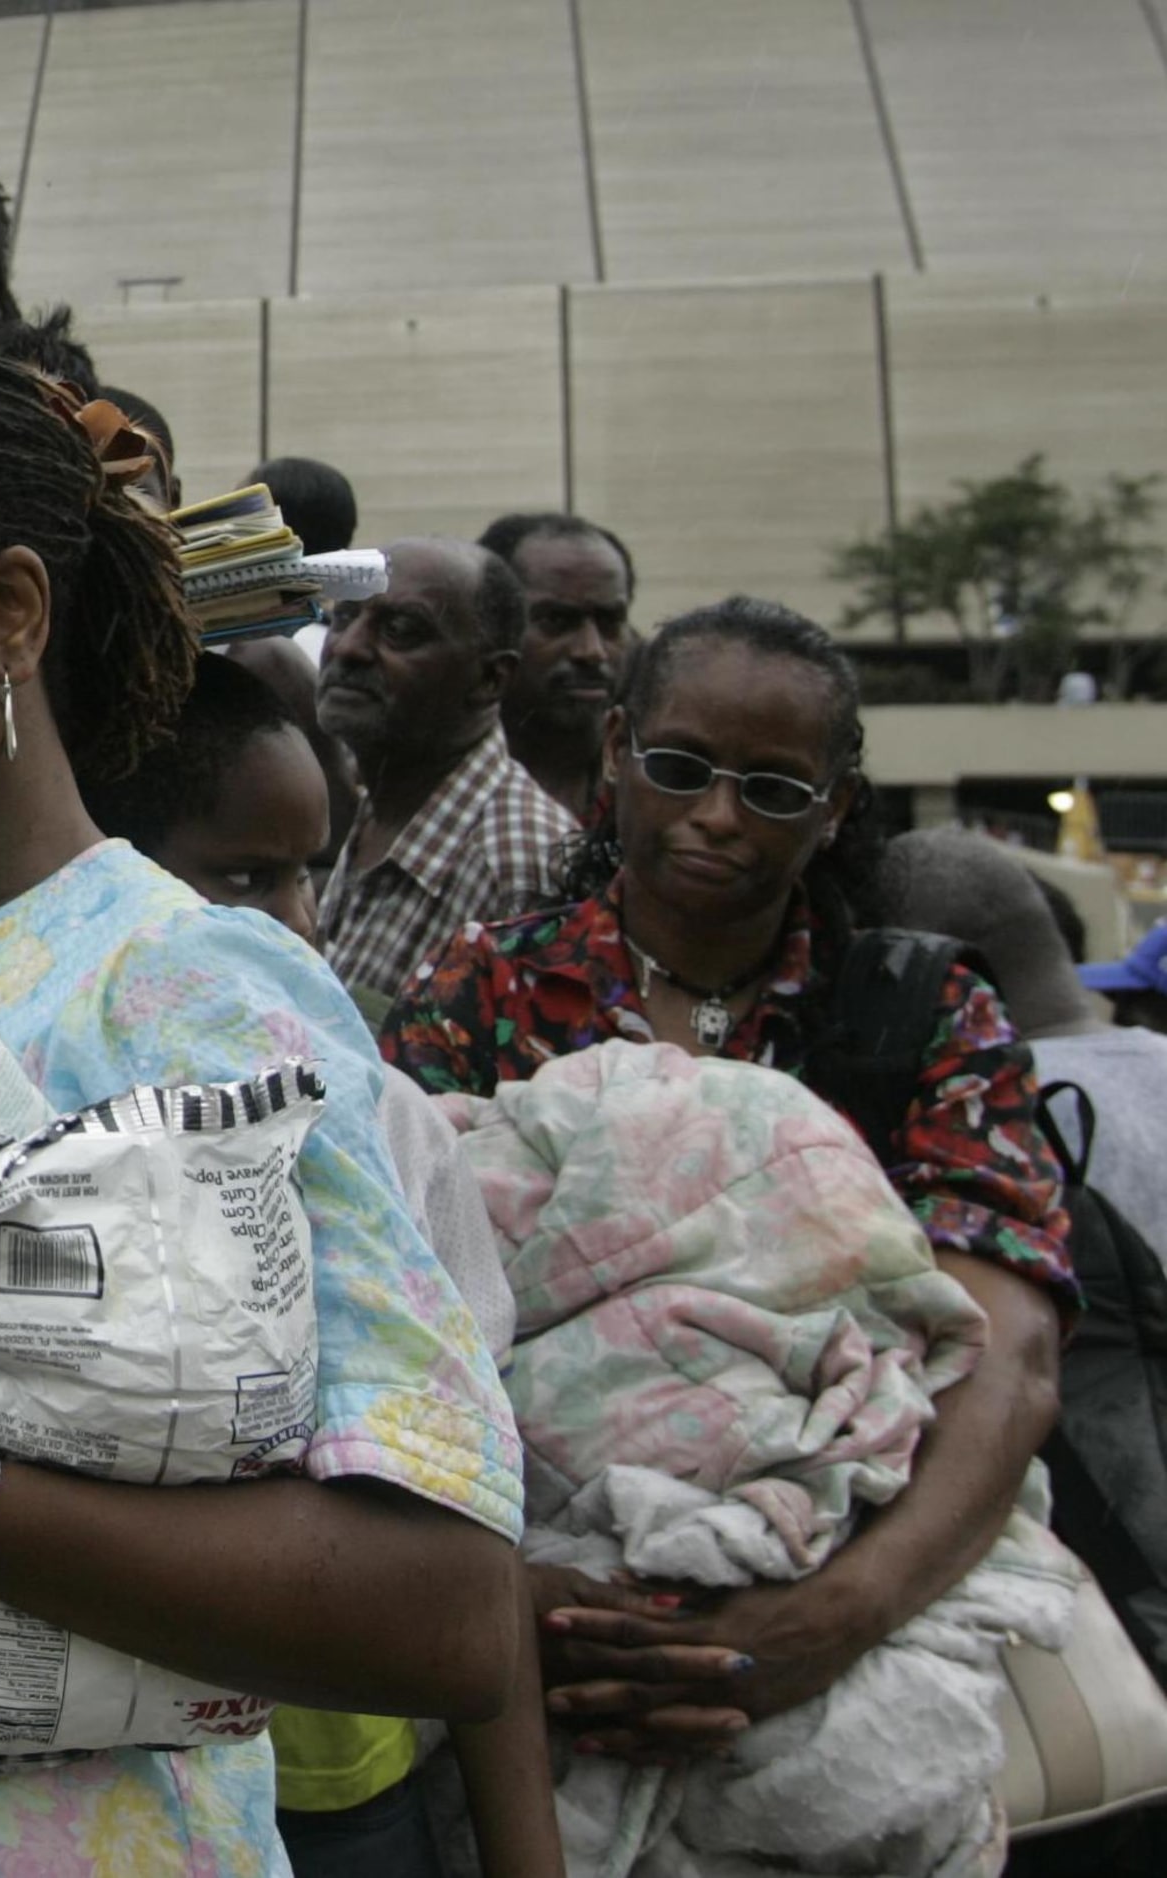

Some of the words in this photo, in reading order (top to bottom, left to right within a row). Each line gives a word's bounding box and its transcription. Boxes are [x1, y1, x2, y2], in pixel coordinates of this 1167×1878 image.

[72, 1173, 92, 1184] DATE
[219, 1186, 257, 1203] Curls
[221, 1205, 256, 1220] Corn
[230, 1221, 266, 1239] Chips
[251, 1271, 279, 1292] Chips
[37, 1335, 50, 1346] FL
[48, 1349, 102, 1361] Winn-Dixie
